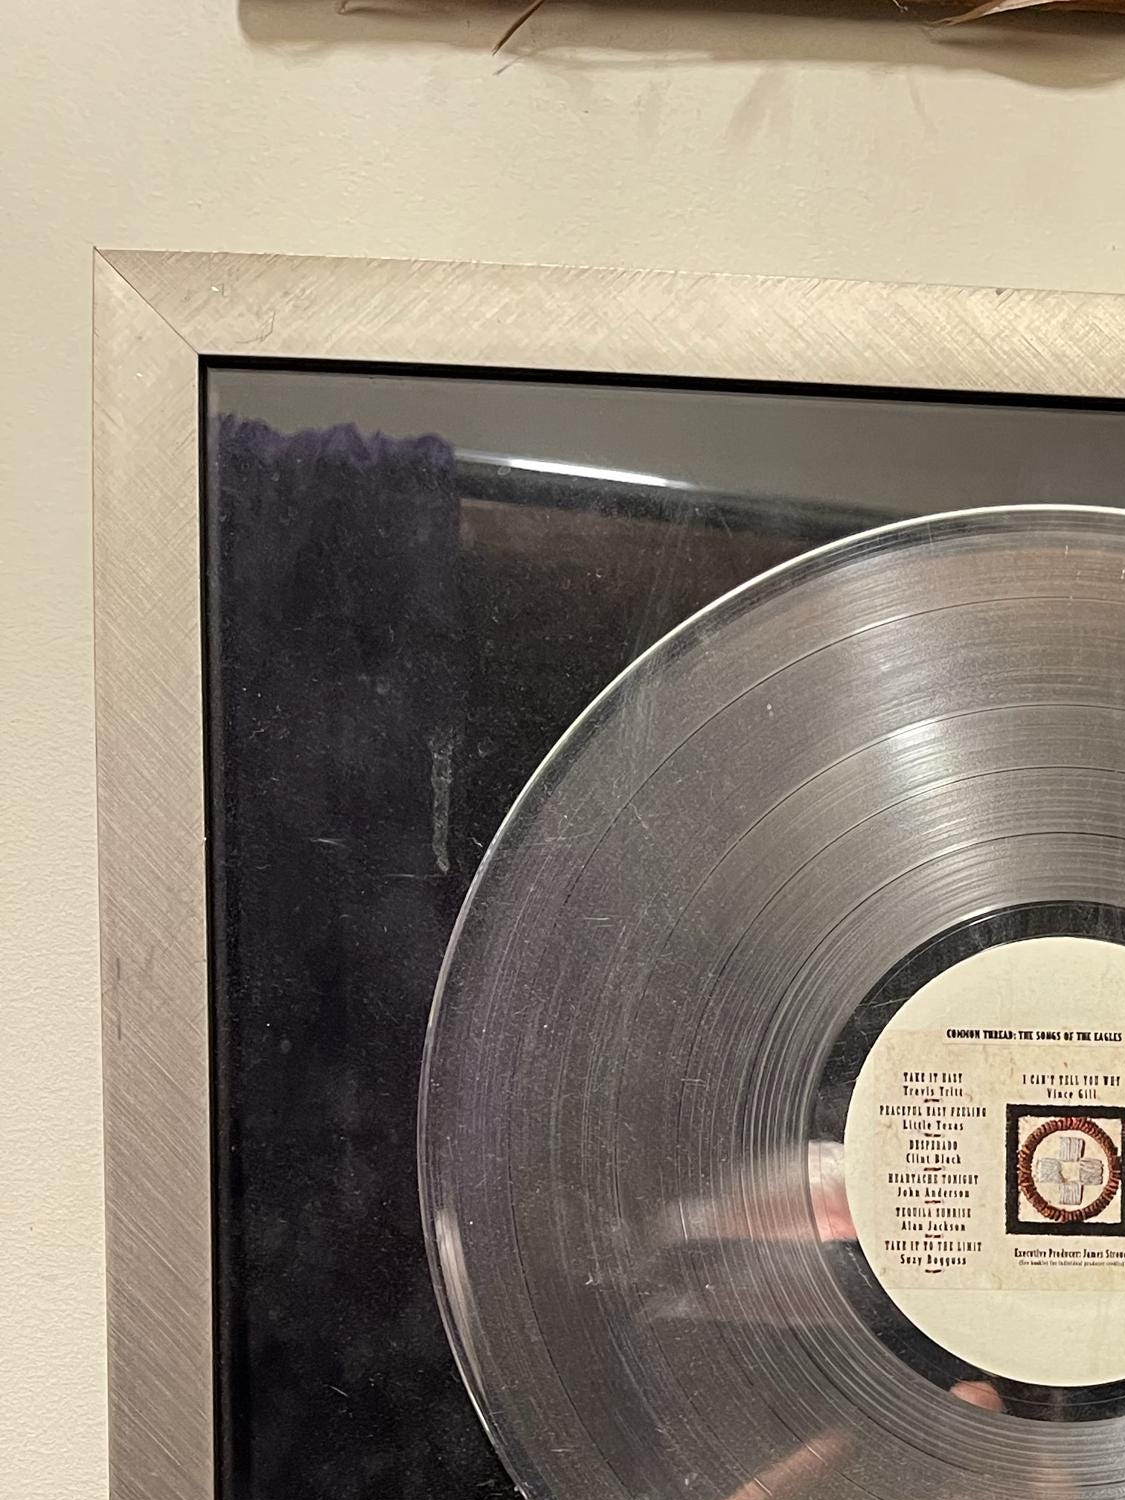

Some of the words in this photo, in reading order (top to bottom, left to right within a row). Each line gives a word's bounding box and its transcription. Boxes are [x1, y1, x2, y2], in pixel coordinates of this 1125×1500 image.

[946, 1029, 980, 1039] COMMON
[983, 1030, 1016, 1040] THREAD:
[1018, 1031, 1033, 1040] THE
[1036, 1031, 1061, 1040] SONGS
[1064, 1032, 1074, 1041] OF
[1076, 1032, 1091, 1041] THE
[1094, 1032, 1122, 1042] EAGLES
[1047, 1088, 1074, 1099] Vince
[1078, 1088, 1097, 1099] Gill
[898, 1187, 920, 1198] John
[925, 1187, 969, 1198] Anderson
[901, 1221, 923, 1231] Alan
[928, 1221, 965, 1231] Jackson
